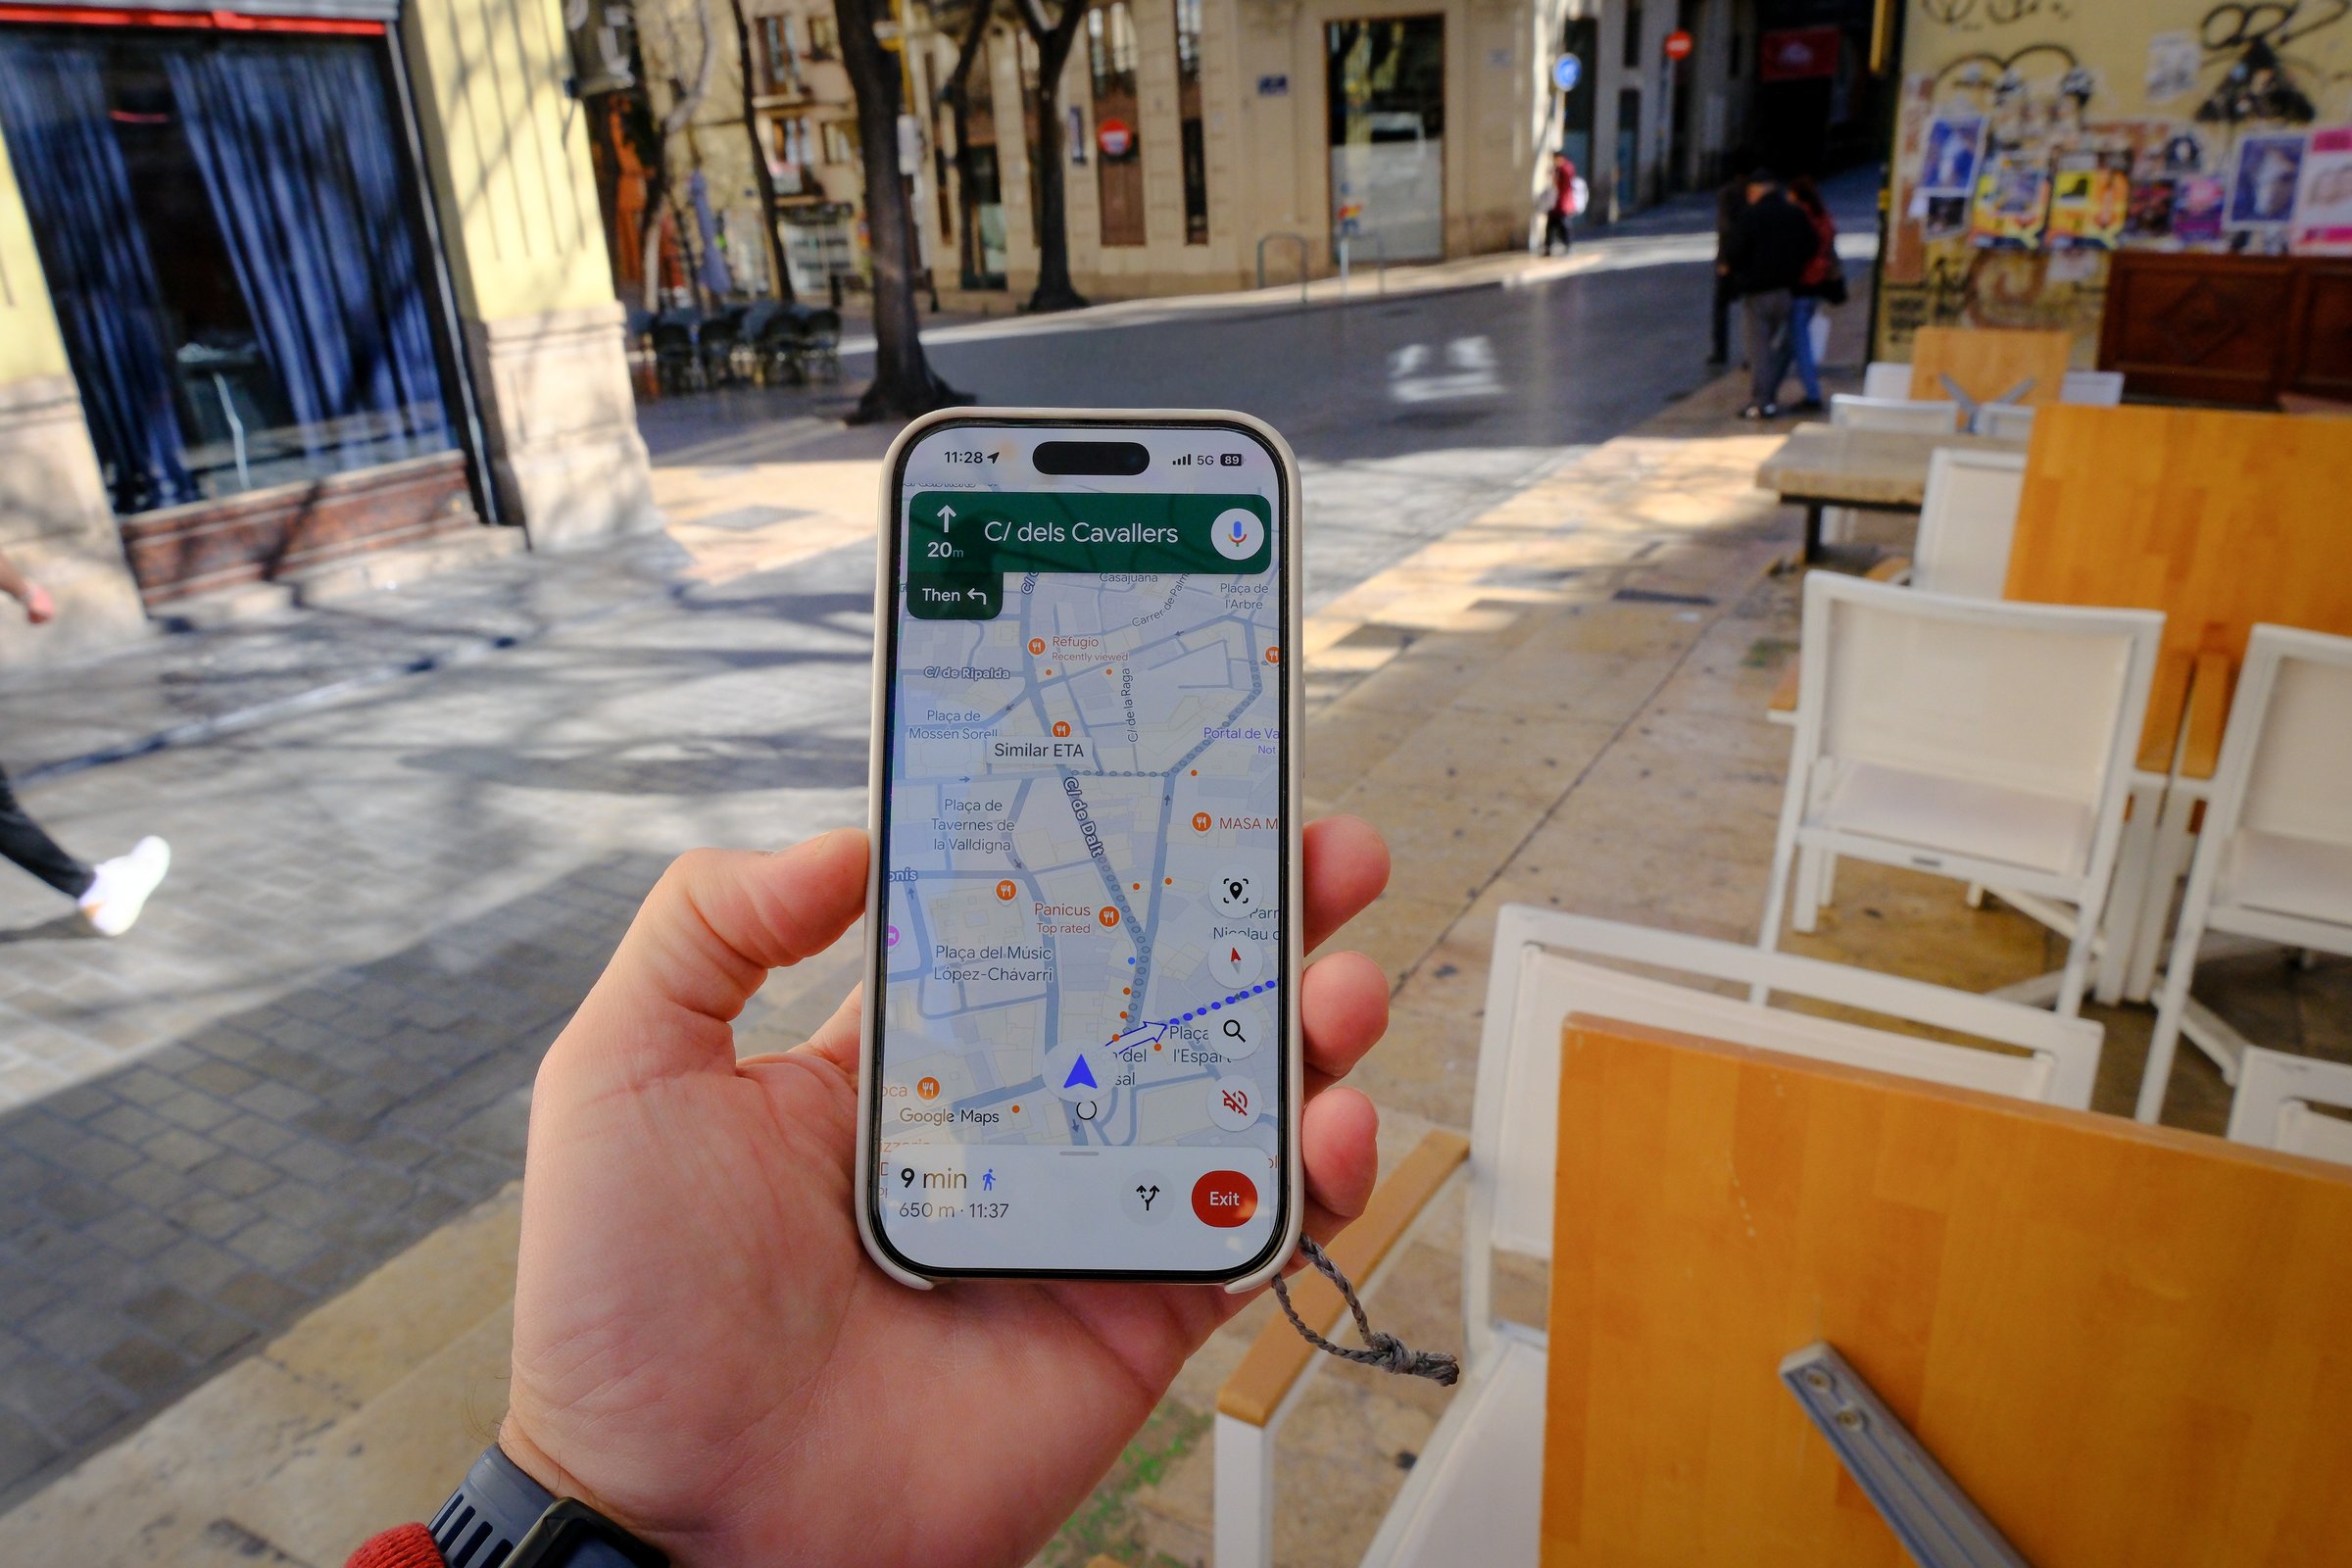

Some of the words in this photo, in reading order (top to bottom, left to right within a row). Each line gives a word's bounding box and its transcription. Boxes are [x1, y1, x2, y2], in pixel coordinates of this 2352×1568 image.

[944, 451, 983, 464] 11:28
[1197, 456, 1214, 466] 5G
[1224, 456, 1240, 465] 89
[984, 521, 1011, 542] C/
[1017, 522, 1065, 542] dels
[1071, 522, 1178, 543] Cavallers
[1100, 572, 1158, 585] Casajuana
[922, 588, 960, 602] Then
[1220, 583, 1251, 596] Plaça
[1253, 583, 1269, 594] de
[1225, 599, 1263, 611] l'Arbre
[1131, 610, 1164, 627] Carrer
[1163, 598, 1175, 612] de
[1053, 636, 1100, 650] Refugio
[1052, 652, 1093, 662] Recently
[1095, 652, 1129, 662] viewed
[924, 666, 941, 678] C/
[942, 667, 958, 679] de
[961, 667, 1010, 681] Ripalda
[1121, 668, 1134, 697] Raga
[1124, 699, 1133, 710] la
[927, 710, 961, 724] Plaça
[964, 710, 980, 721] de
[1126, 711, 1136, 726] de
[909, 727, 959, 740] Mossén
[962, 727, 998, 740] Sorell
[1128, 729, 1138, 743] C/
[1203, 727, 1241, 739] Portal
[1245, 727, 1261, 739] de
[994, 743, 1049, 758] Similar
[1054, 744, 1084, 758] ETA
[1258, 745, 1276, 755] Not
[1063, 777, 1082, 797] C/
[945, 799, 980, 814] Plaça
[985, 800, 1003, 811] de
[1072, 800, 1088, 821] de
[932, 818, 993, 831] Tavernes
[997, 818, 1015, 831] de
[1219, 817, 1261, 830] MASA
[1266, 817, 1278, 830] M
[934, 839, 945, 851] la
[949, 839, 1011, 854] Valldigna
[1080, 821, 1103, 858] Dalt
[1034, 903, 1091, 916] Panicus
[1036, 922, 1057, 934] Top
[1060, 923, 1091, 934] rated
[936, 945, 975, 961] Plaça
[980, 946, 1003, 959] del
[1007, 946, 1052, 959] Músic
[934, 966, 1053, 983] López-Chávarri
[1169, 1025, 1208, 1044] Plaça
[1123, 1049, 1147, 1062] del
[900, 1107, 955, 1126] Google
[960, 1109, 1000, 1127] Maps
[901, 1167, 915, 1189] 9
[923, 1167, 967, 1189] min
[1209, 1191, 1240, 1206] Exit
[899, 1201, 933, 1218] 650
[938, 1205, 955, 1217] m
[969, 1202, 1009, 1218] 11:37
